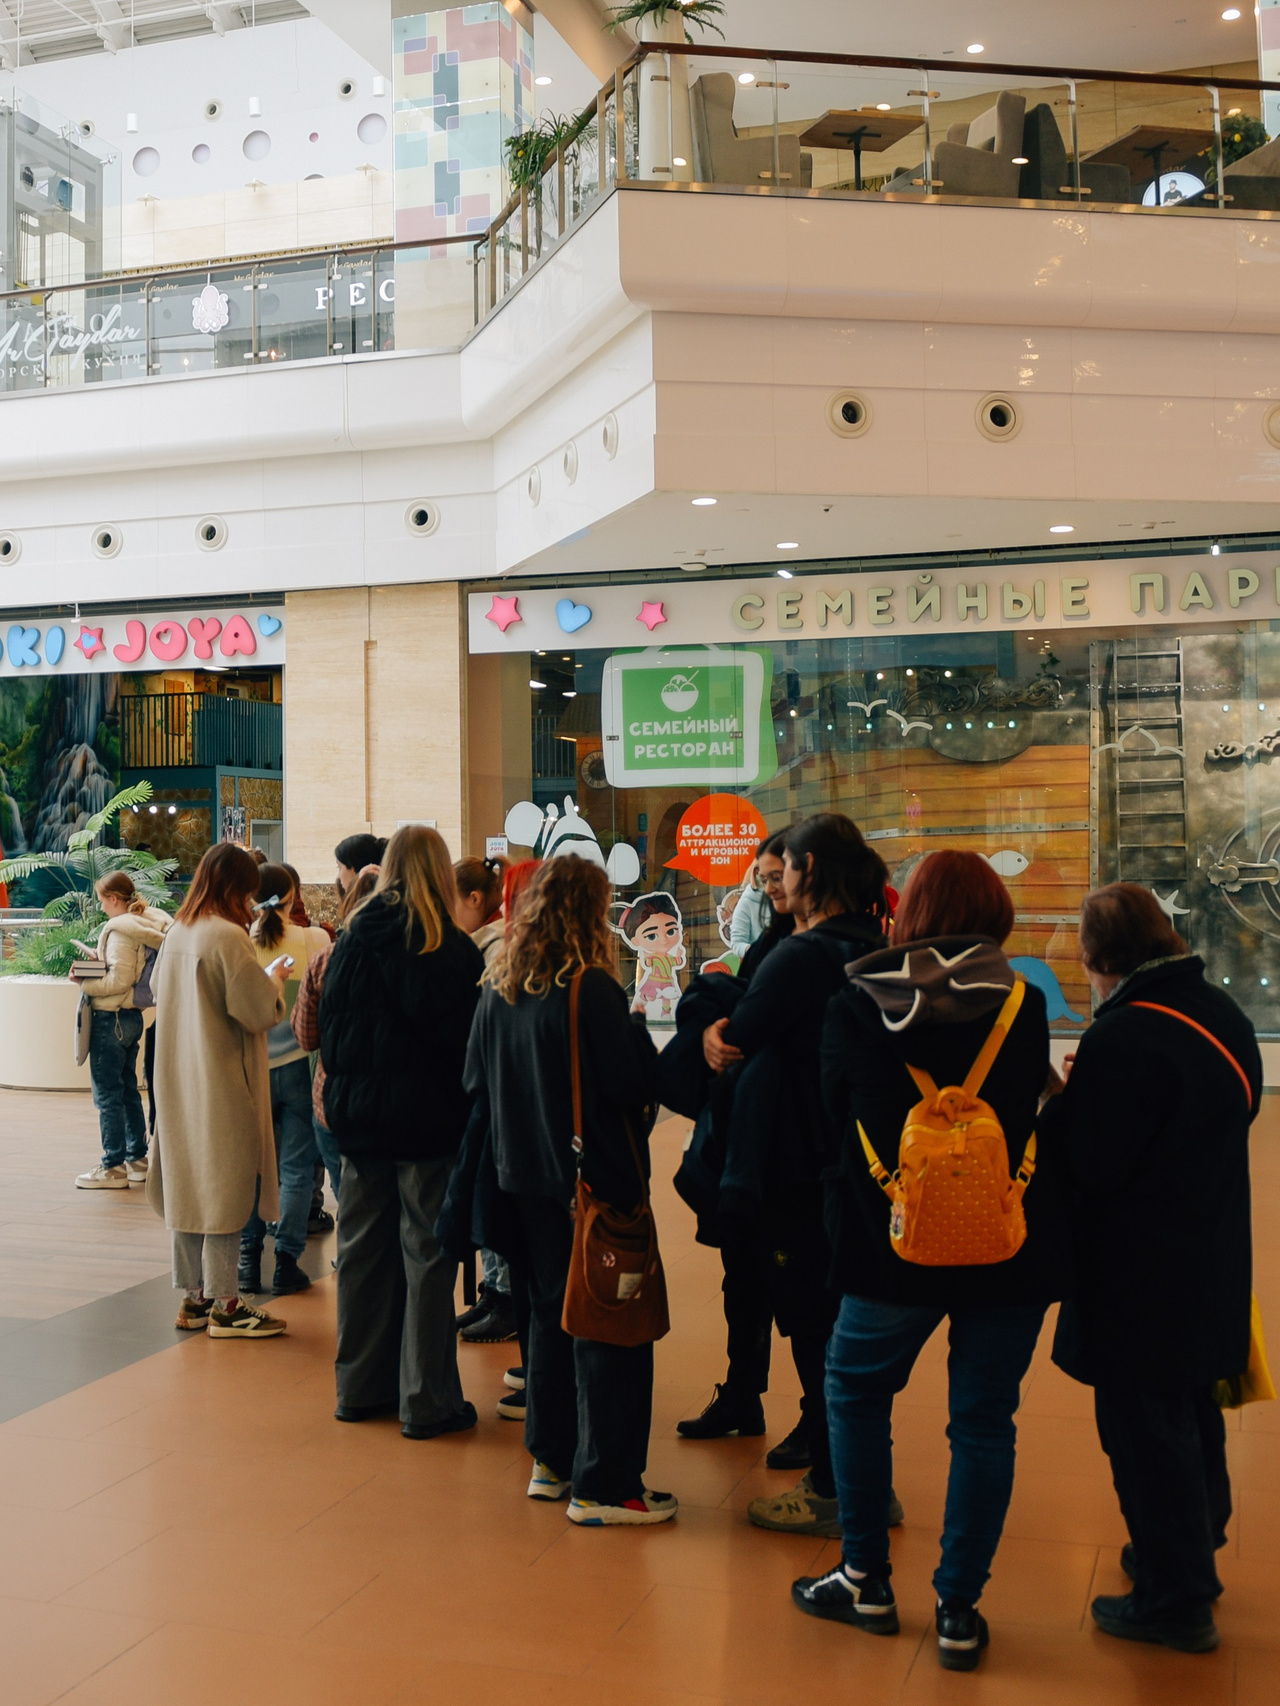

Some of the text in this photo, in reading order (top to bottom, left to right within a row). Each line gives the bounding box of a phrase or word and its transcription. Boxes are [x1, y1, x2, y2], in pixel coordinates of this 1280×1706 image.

[83, 353, 141, 370] КУХНЯ
[732, 566, 1280, 630] СЕМЕЙНЫЕ ПАР
[113, 614, 257, 663] JOYA
[629, 714, 738, 737] СЕМЕЙНЫЙ
[634, 741, 734, 759] РЕСТОРАН
[681, 823, 757, 837] БОЛЕЕ 30
[679, 837, 761, 847] АТТРАКЦИОНОВ
[690, 847, 749, 856] И ИГРОВЫХ
[710, 856, 731, 865] ЗОН
